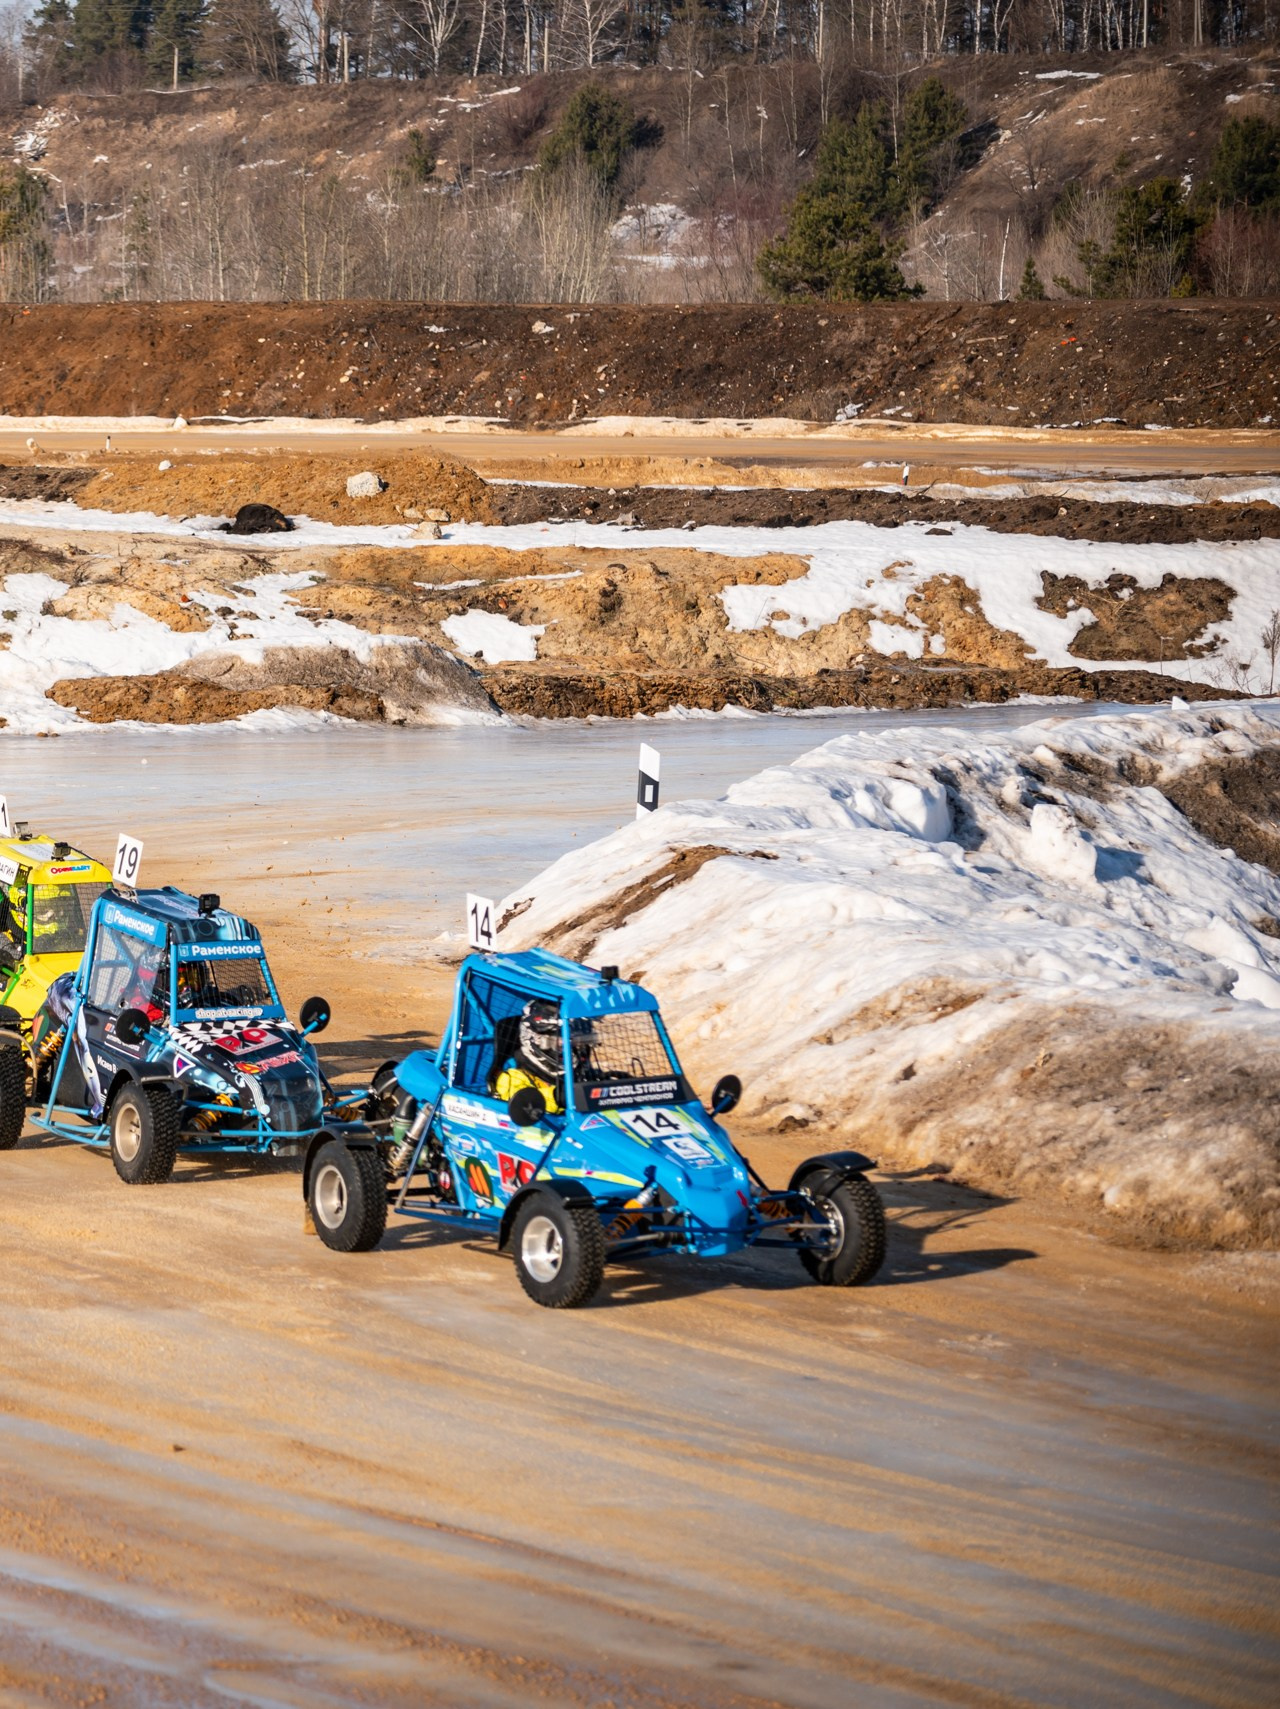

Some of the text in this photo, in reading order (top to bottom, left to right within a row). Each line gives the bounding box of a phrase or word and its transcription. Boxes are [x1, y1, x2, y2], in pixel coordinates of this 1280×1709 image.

[118, 843, 139, 879] 19
[113, 909, 155, 936] Раменское
[471, 902, 493, 946] 14
[191, 944, 262, 957] Раменское
[609, 1081, 677, 1097] COOLSTREAM
[632, 1112, 680, 1133] 14
